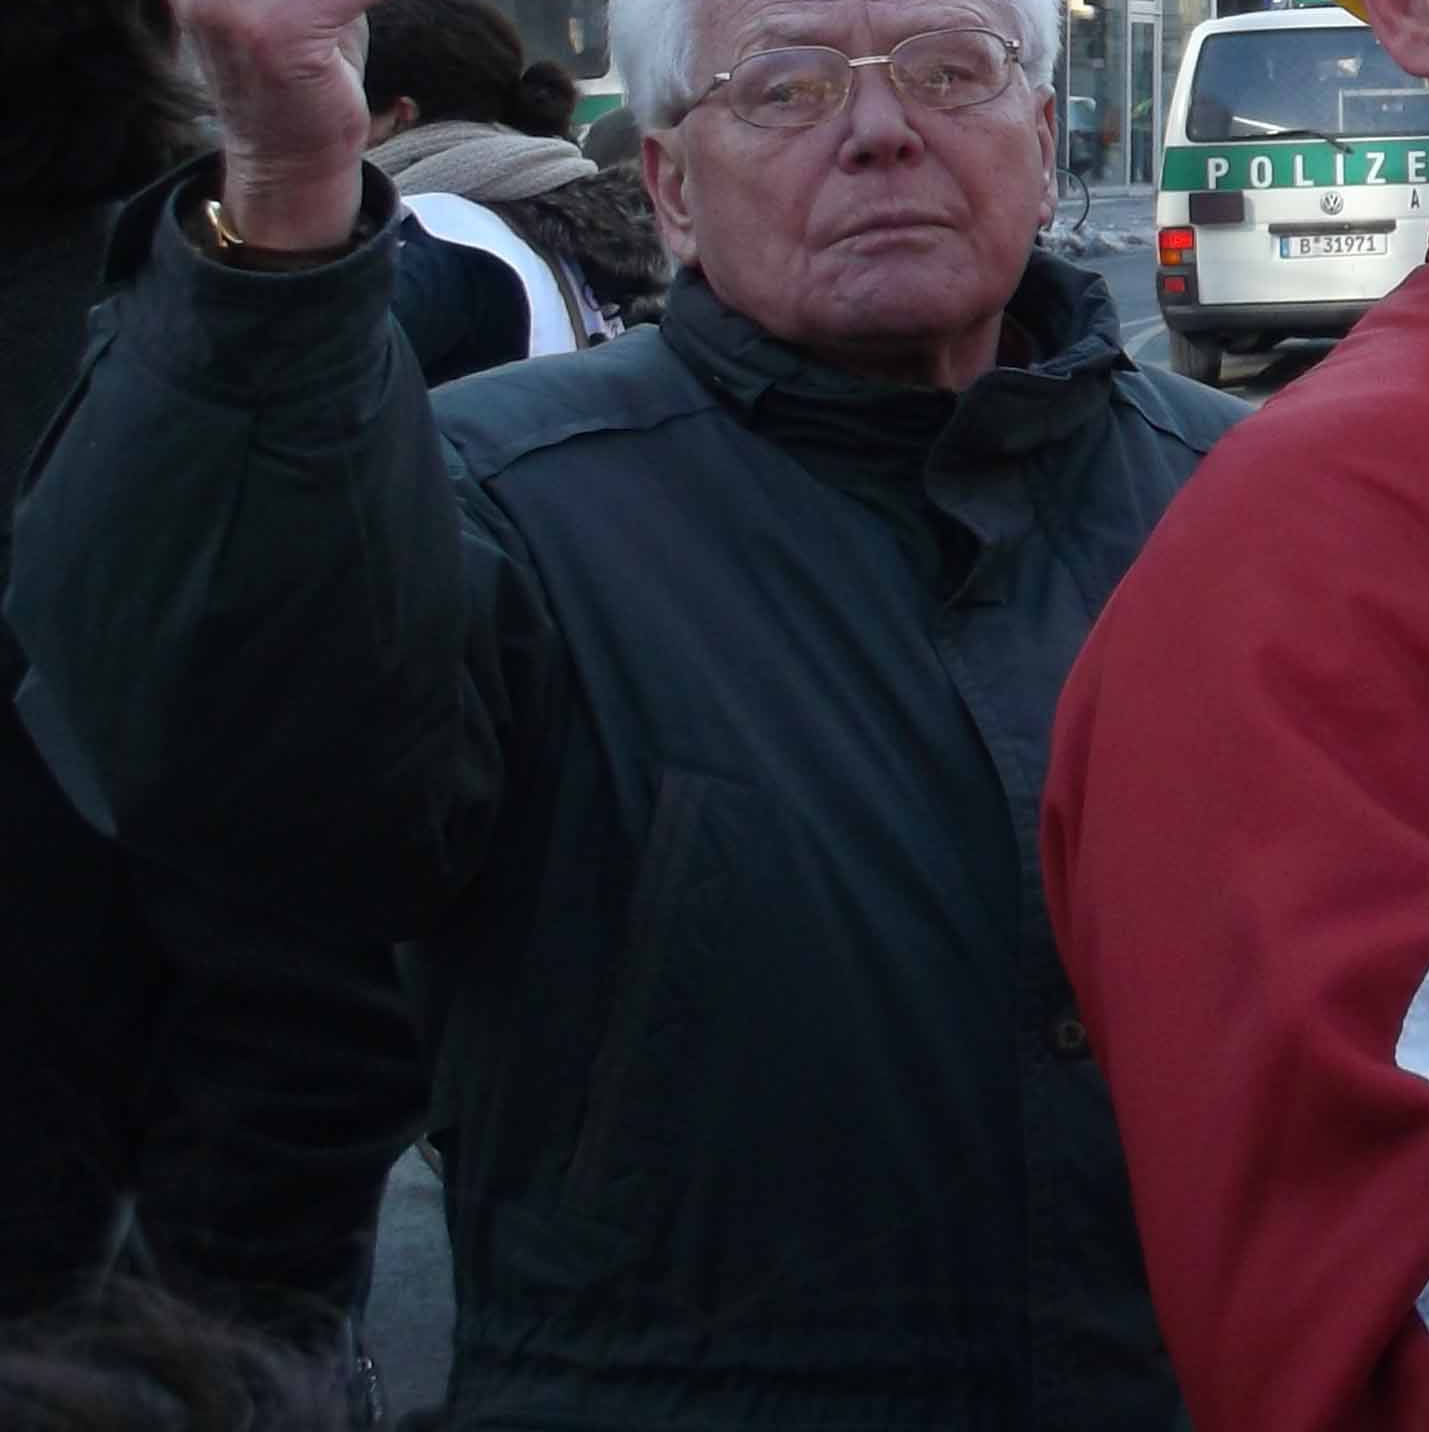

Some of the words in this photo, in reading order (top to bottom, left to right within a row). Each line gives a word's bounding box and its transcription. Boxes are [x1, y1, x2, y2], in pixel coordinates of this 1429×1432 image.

[1207, 150, 1428, 189] POLIZE
[1411, 189, 1420, 209] A
[1323, 236, 1376, 253] 31971
